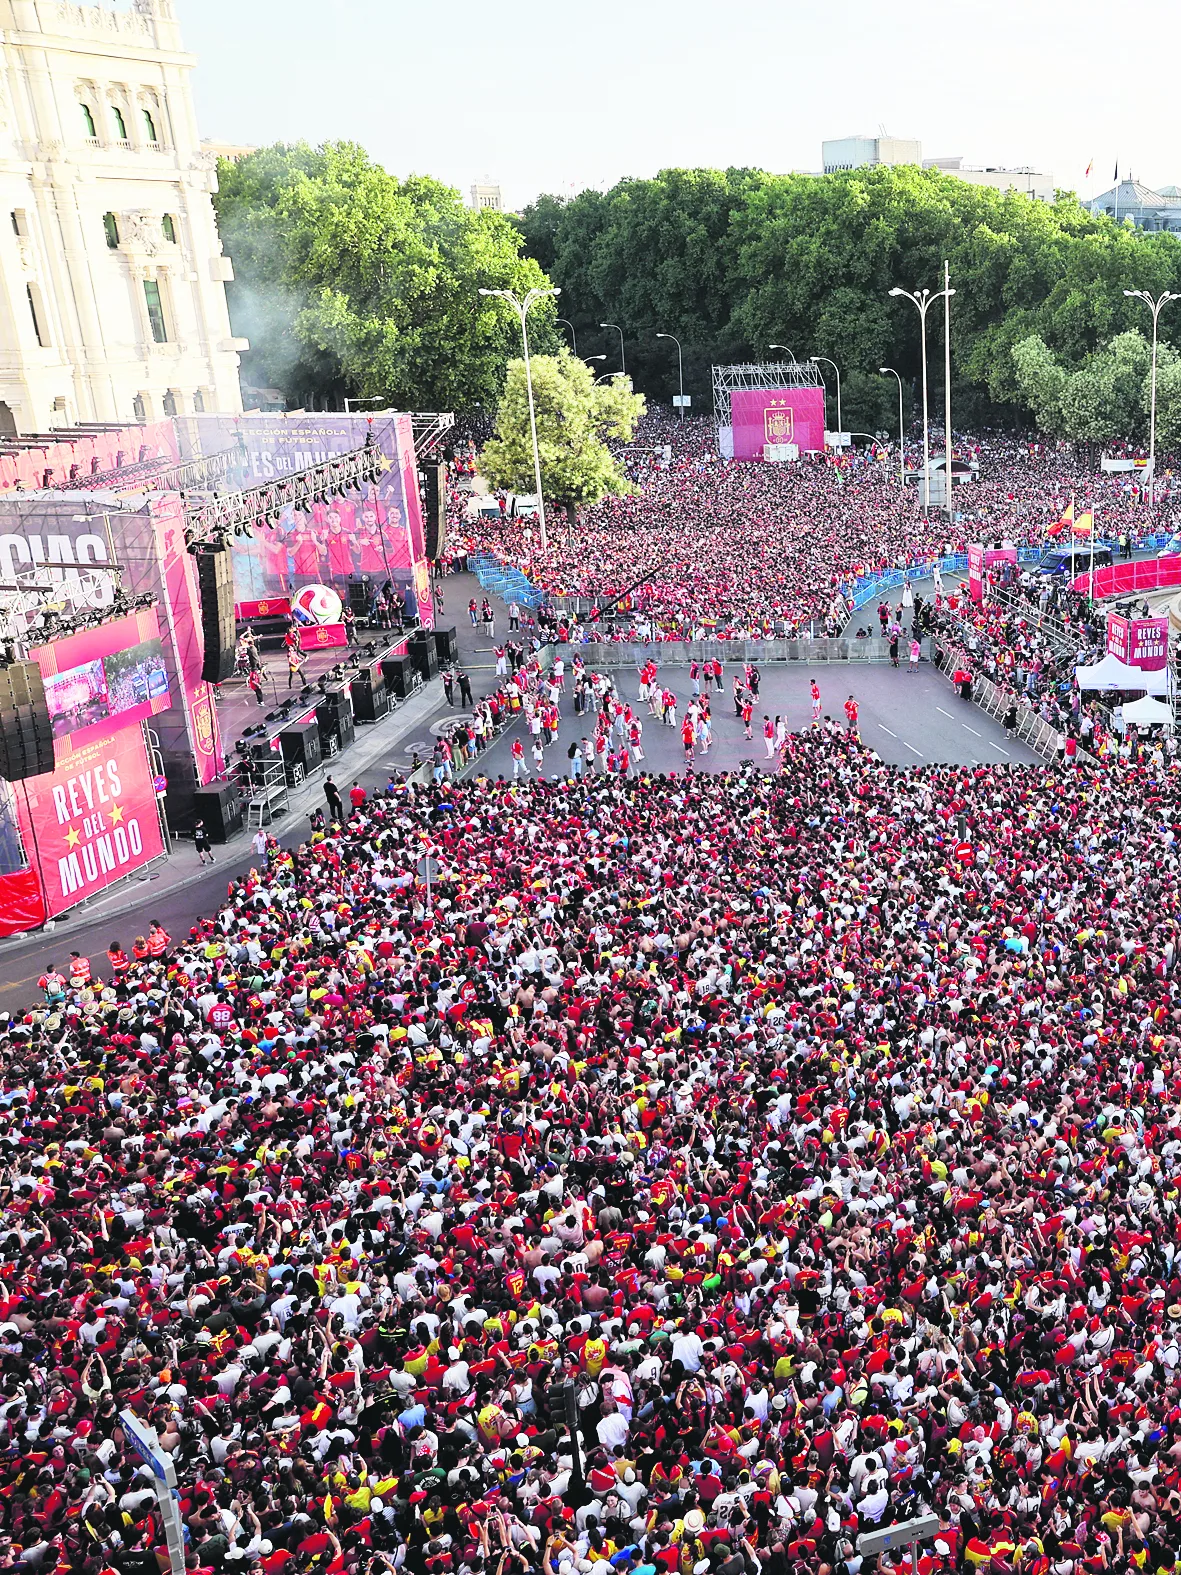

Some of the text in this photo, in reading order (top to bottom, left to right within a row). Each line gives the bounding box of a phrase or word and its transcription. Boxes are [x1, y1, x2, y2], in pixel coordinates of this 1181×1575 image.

[1138, 627, 1161, 640] REYES
[1134, 645, 1164, 659] MUNDO
[56, 736, 116, 768] ECCIÓN ESPAÑOLA
[64, 752, 100, 772] DE FÚTBOL
[52, 758, 122, 826] REYES
[82, 810, 106, 838] DEL
[58, 818, 143, 897] MUNDO
[212, 1010, 230, 1022] 88
[512, 1280, 523, 1294] 12
